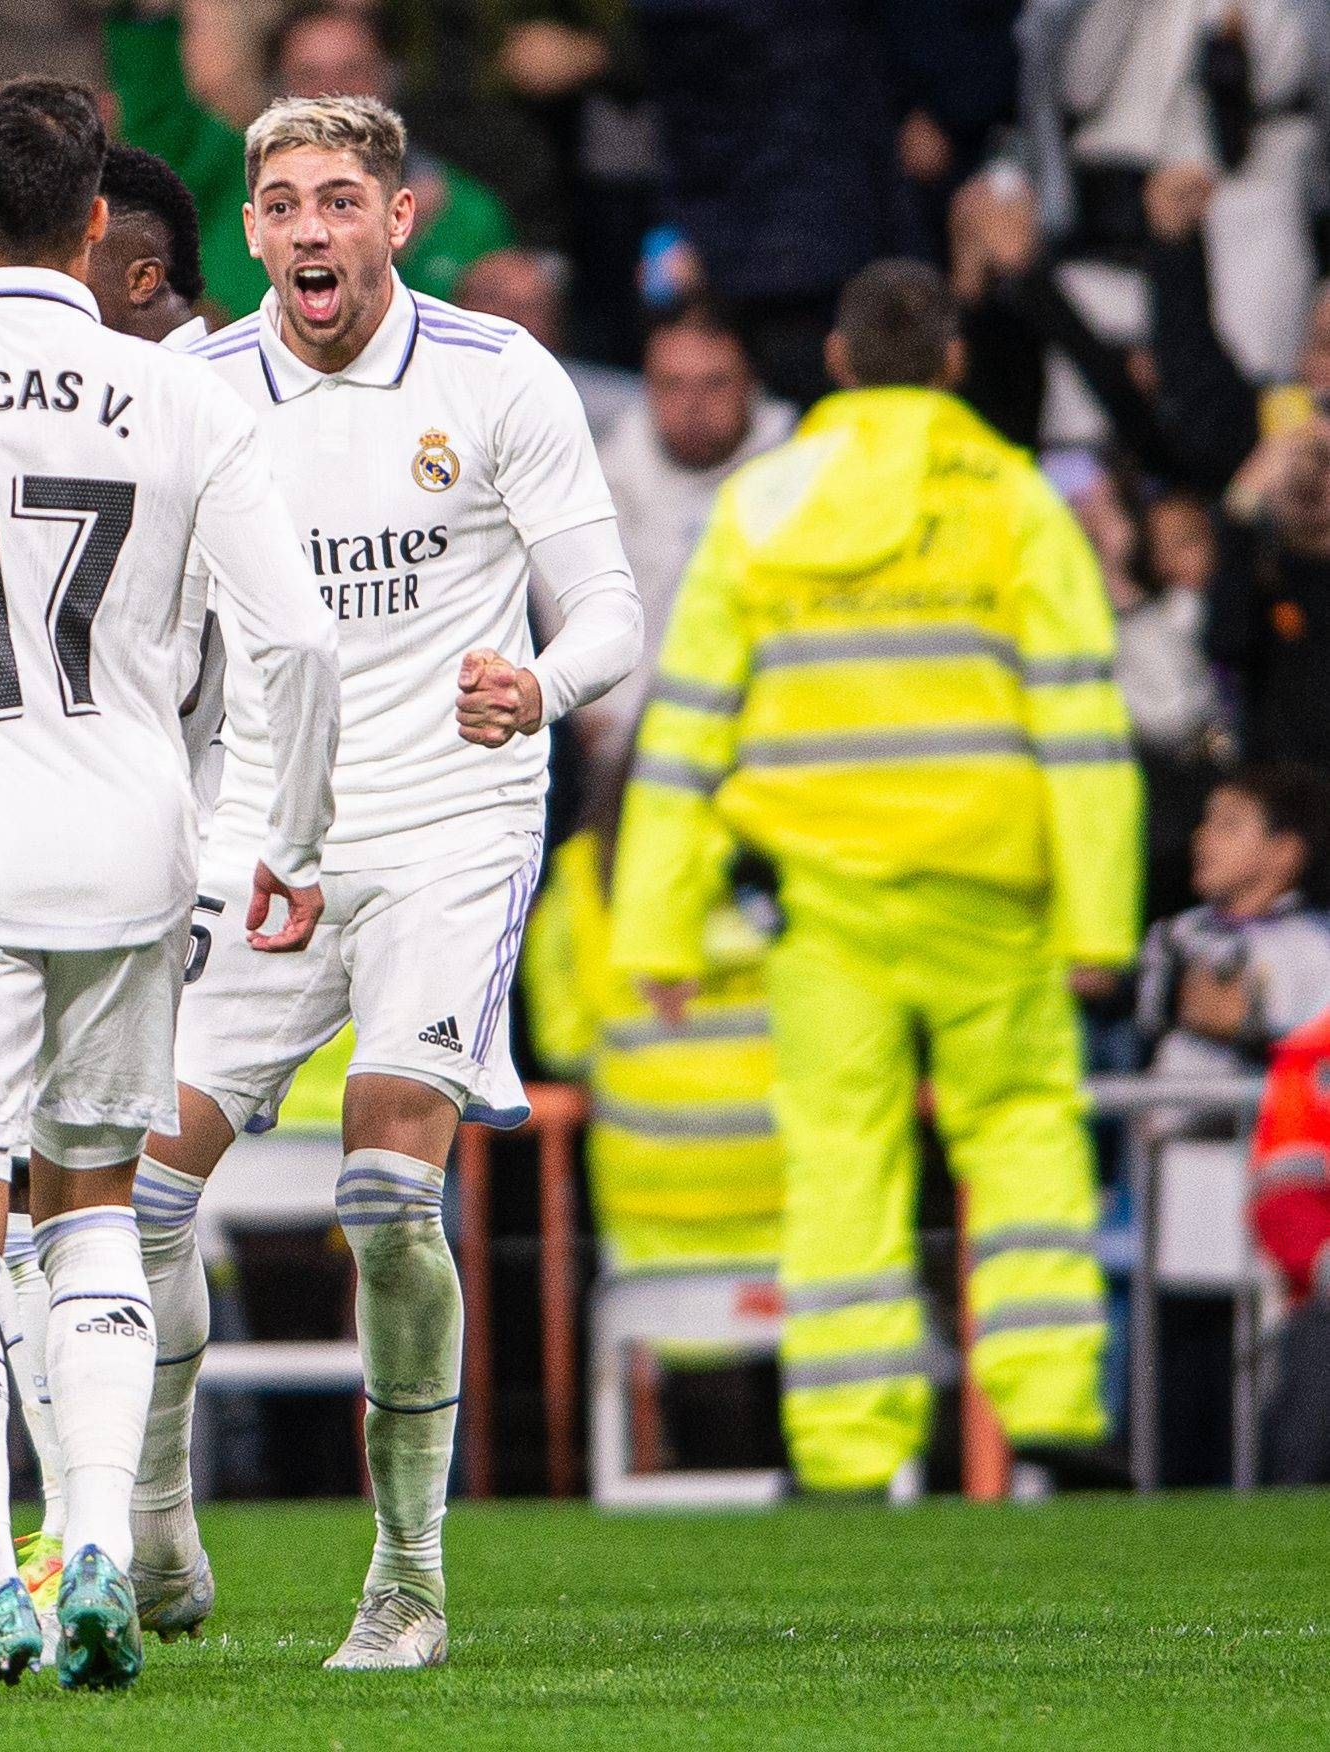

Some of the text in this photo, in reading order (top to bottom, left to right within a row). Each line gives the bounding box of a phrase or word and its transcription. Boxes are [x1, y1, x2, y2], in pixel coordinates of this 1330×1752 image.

[97, 382, 133, 439] V.
[301, 525, 448, 576] irates
[418, 1031, 463, 1053] adidas
